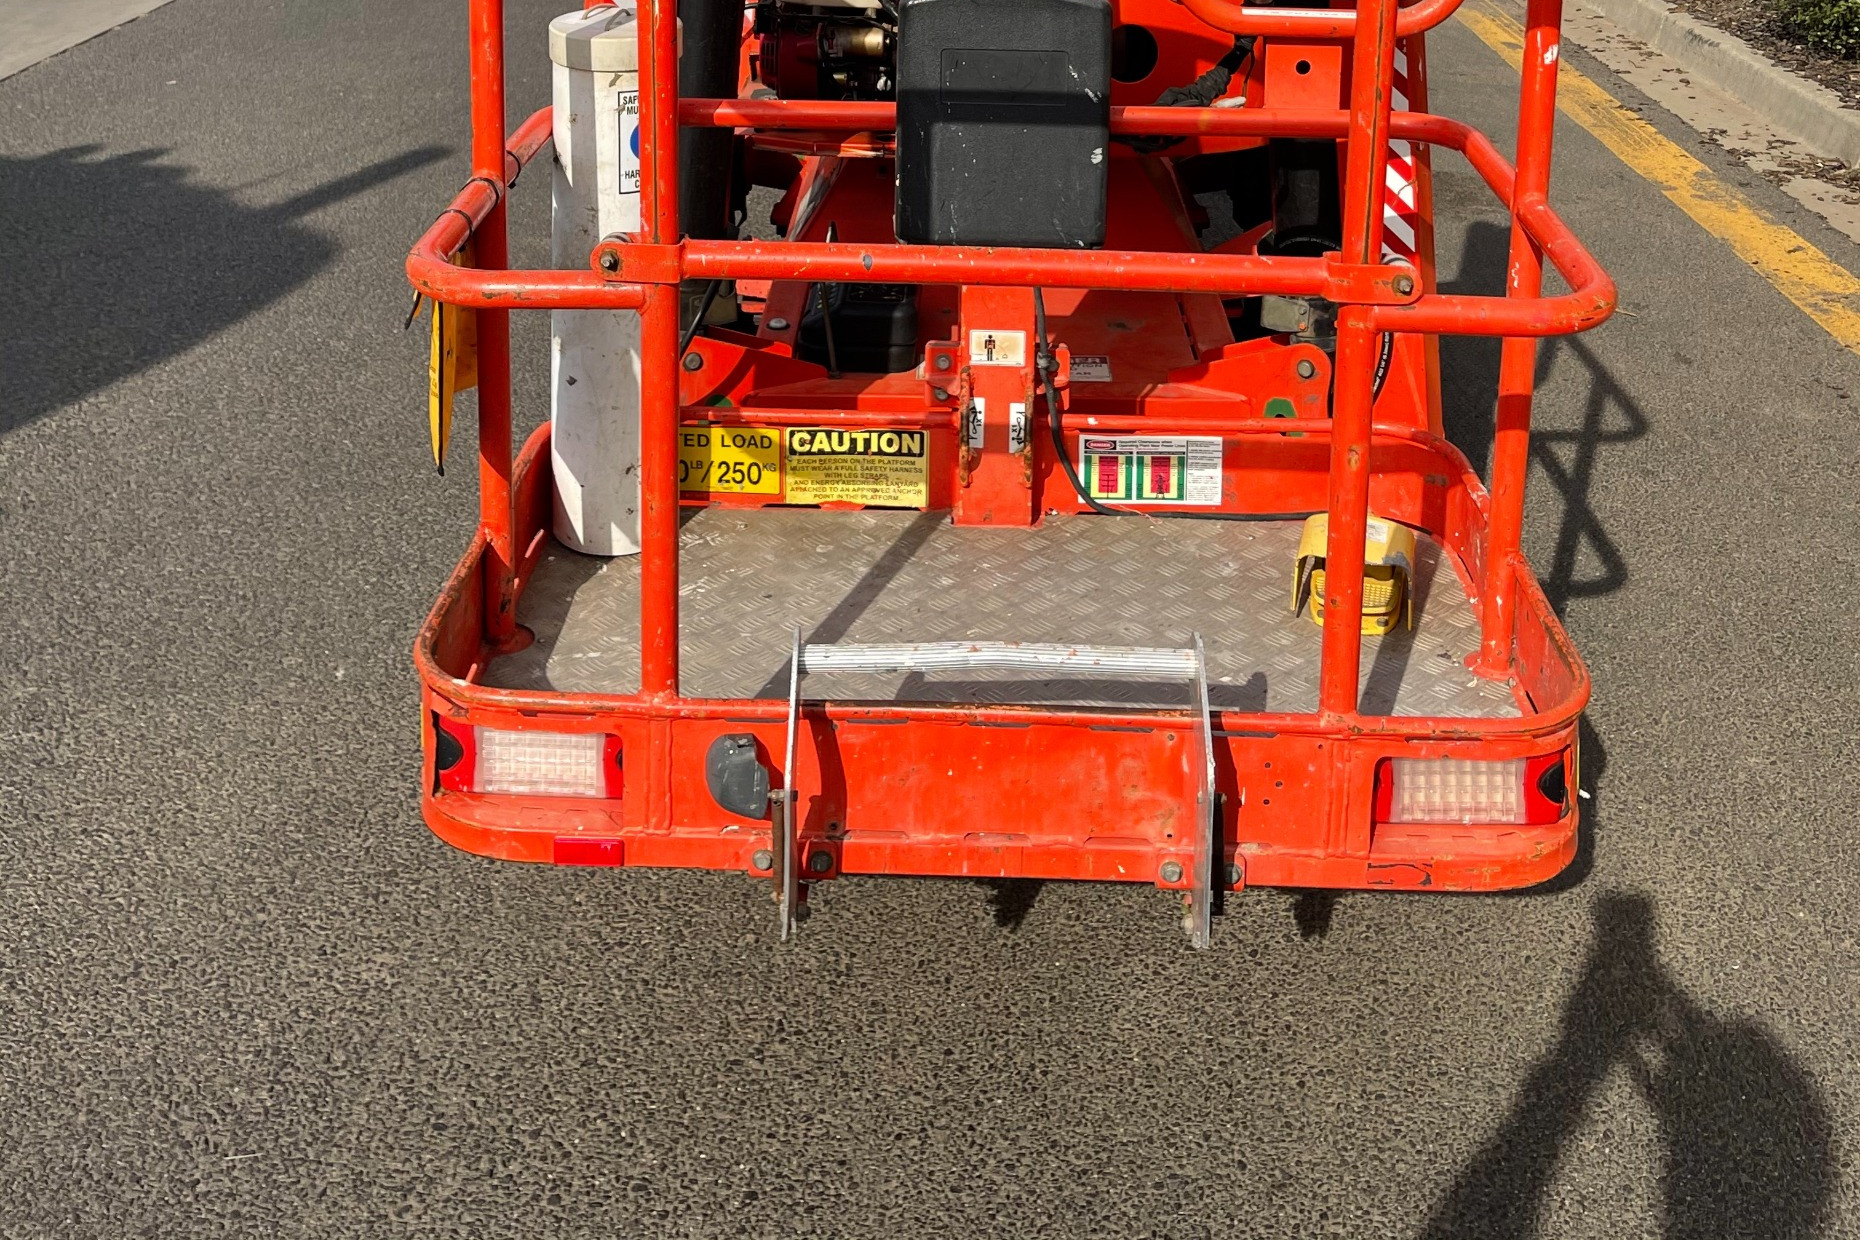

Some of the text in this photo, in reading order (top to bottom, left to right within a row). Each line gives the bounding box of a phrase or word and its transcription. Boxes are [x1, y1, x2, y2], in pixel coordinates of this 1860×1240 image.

[623, 96, 639, 106] SAF
[626, 106, 640, 115] MU
[624, 169, 640, 180] HAR
[679, 433, 773, 449] ED LOAD
[791, 431, 921, 454] CAUTION
[877, 458, 916, 466] PLATFORM
[860, 465, 888, 473] SAFETY
[889, 466, 924, 474] HARNESS
[885, 480, 919, 488] LANYARD
